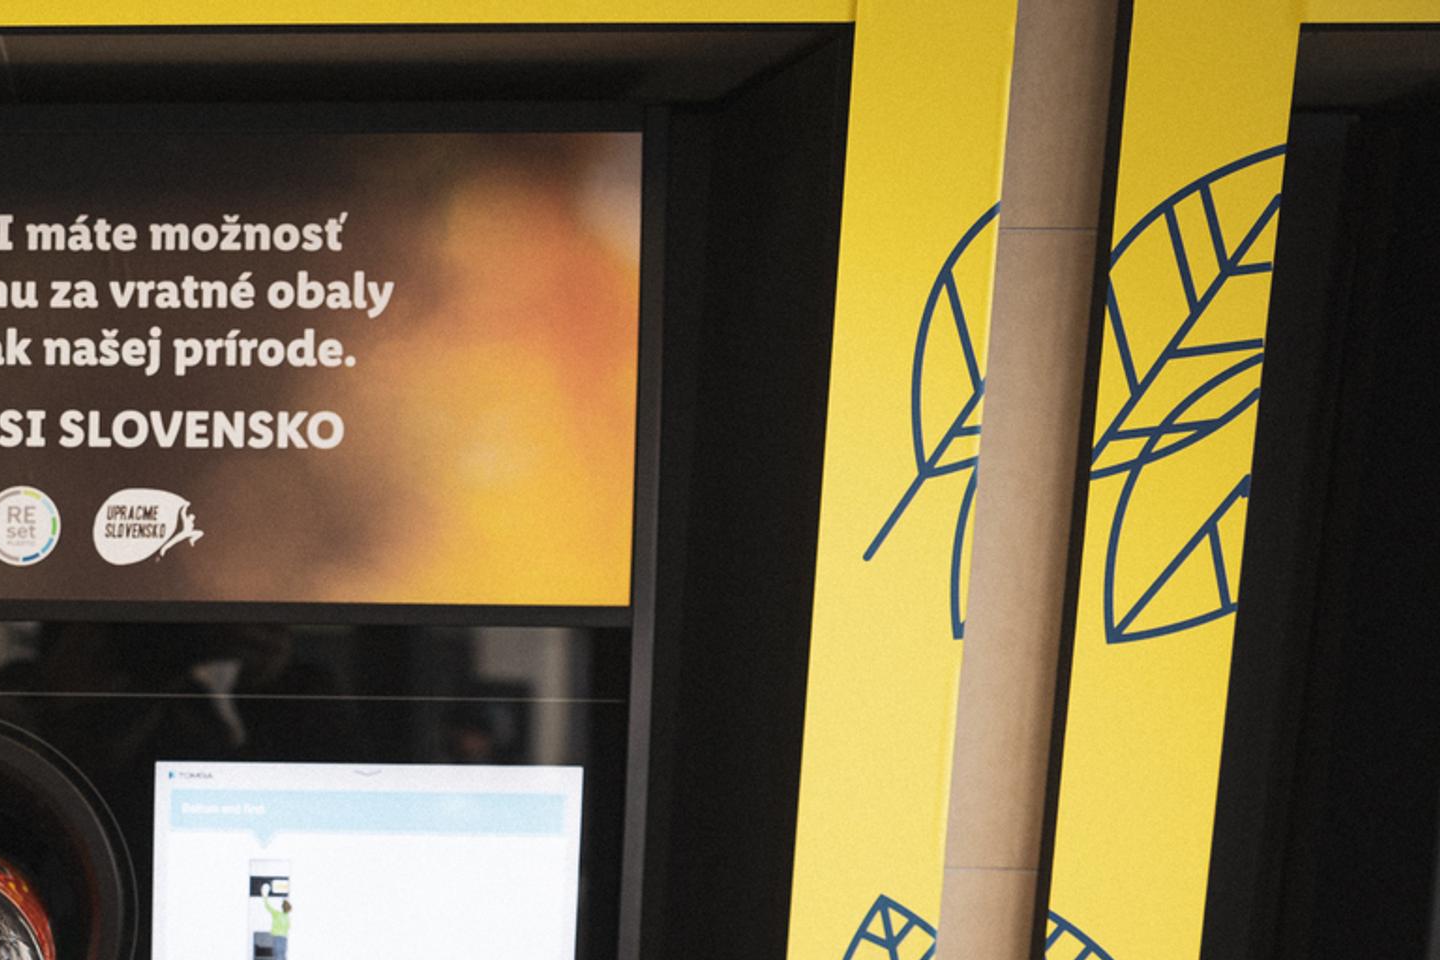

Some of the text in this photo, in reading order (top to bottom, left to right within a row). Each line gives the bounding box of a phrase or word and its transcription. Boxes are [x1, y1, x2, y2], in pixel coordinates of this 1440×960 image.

[25, 214, 138, 252] máte
[149, 211, 348, 252] možnosť
[49, 280, 99, 309] za
[109, 271, 255, 309] vratné
[267, 270, 395, 319] obaly
[42, 327, 162, 377] našej
[172, 327, 357, 377] prírode.
[58, 410, 345, 450] SLOVENSKO
[7, 505, 37, 524] RE
[106, 505, 159, 521] UPRACME
[6, 525, 37, 539] set
[104, 522, 167, 539] SLOVENSKO
